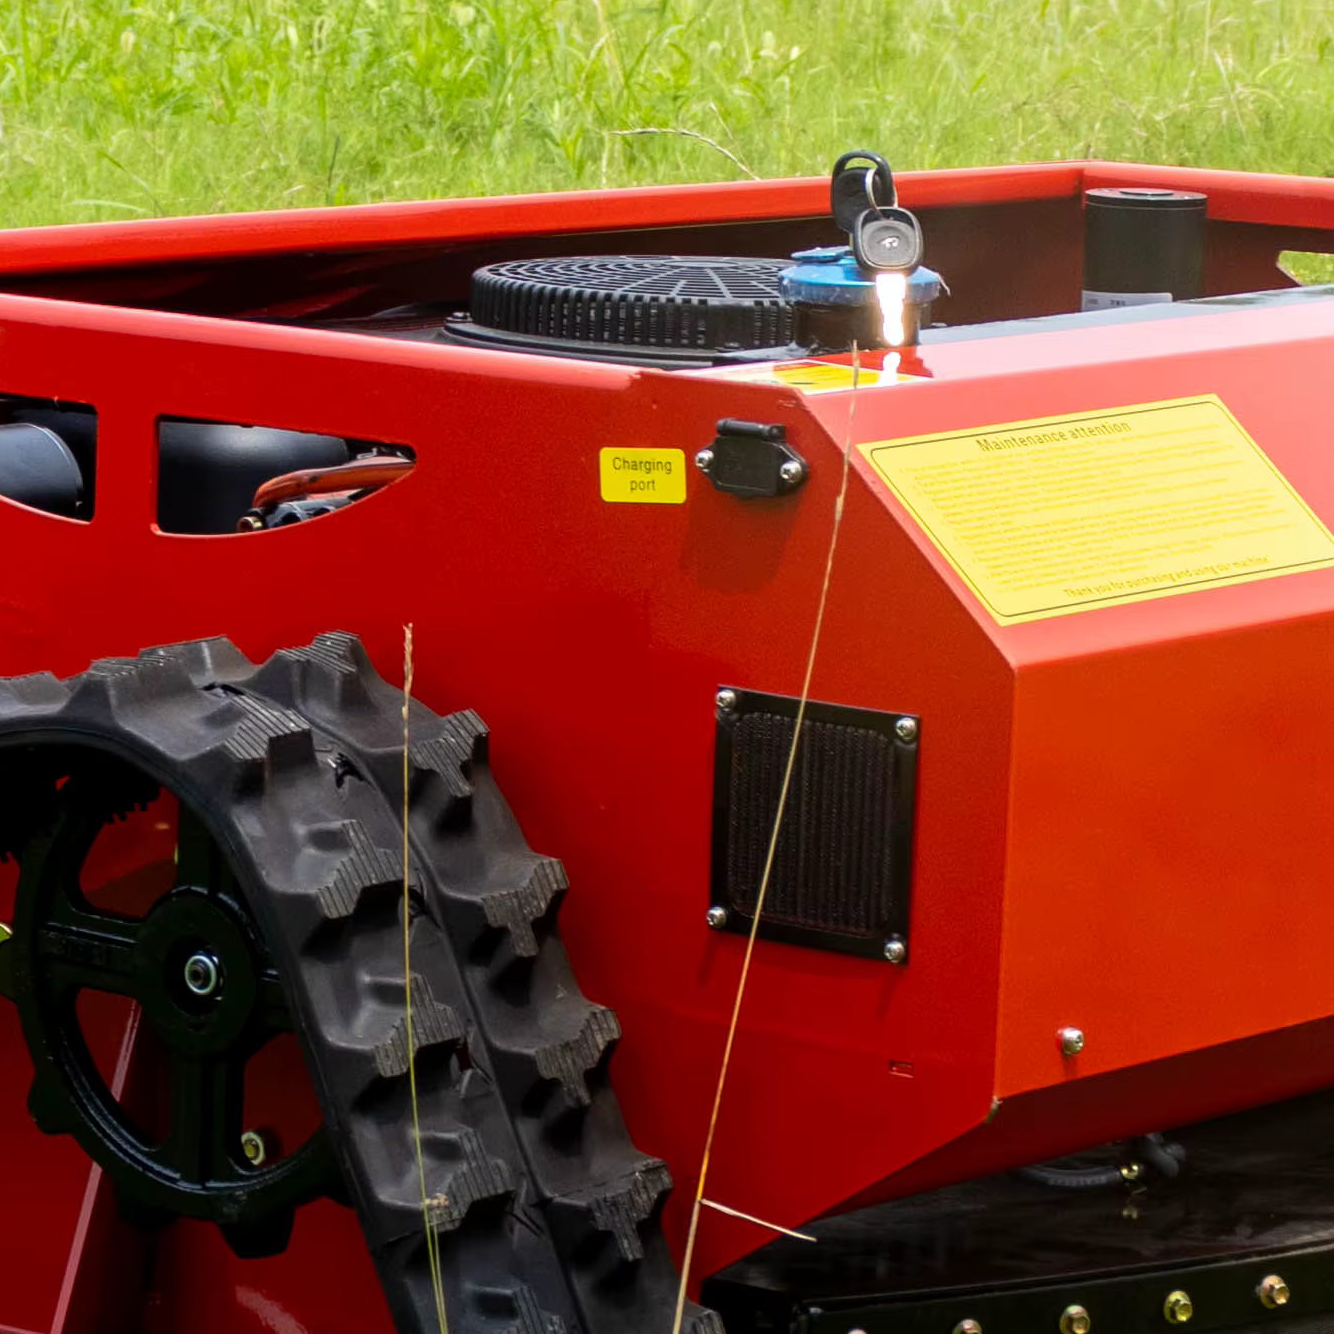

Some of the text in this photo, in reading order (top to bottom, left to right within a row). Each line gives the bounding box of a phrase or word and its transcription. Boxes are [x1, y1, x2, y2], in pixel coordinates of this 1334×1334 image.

[975, 421, 1132, 451] Maintenance attention
[612, 456, 673, 475] Charging
[630, 479, 656, 493] port
[1063, 587, 1093, 597] Thank
[1094, 584, 1109, 595] you
[1109, 581, 1126, 591] for
[1176, 568, 1193, 579] and
